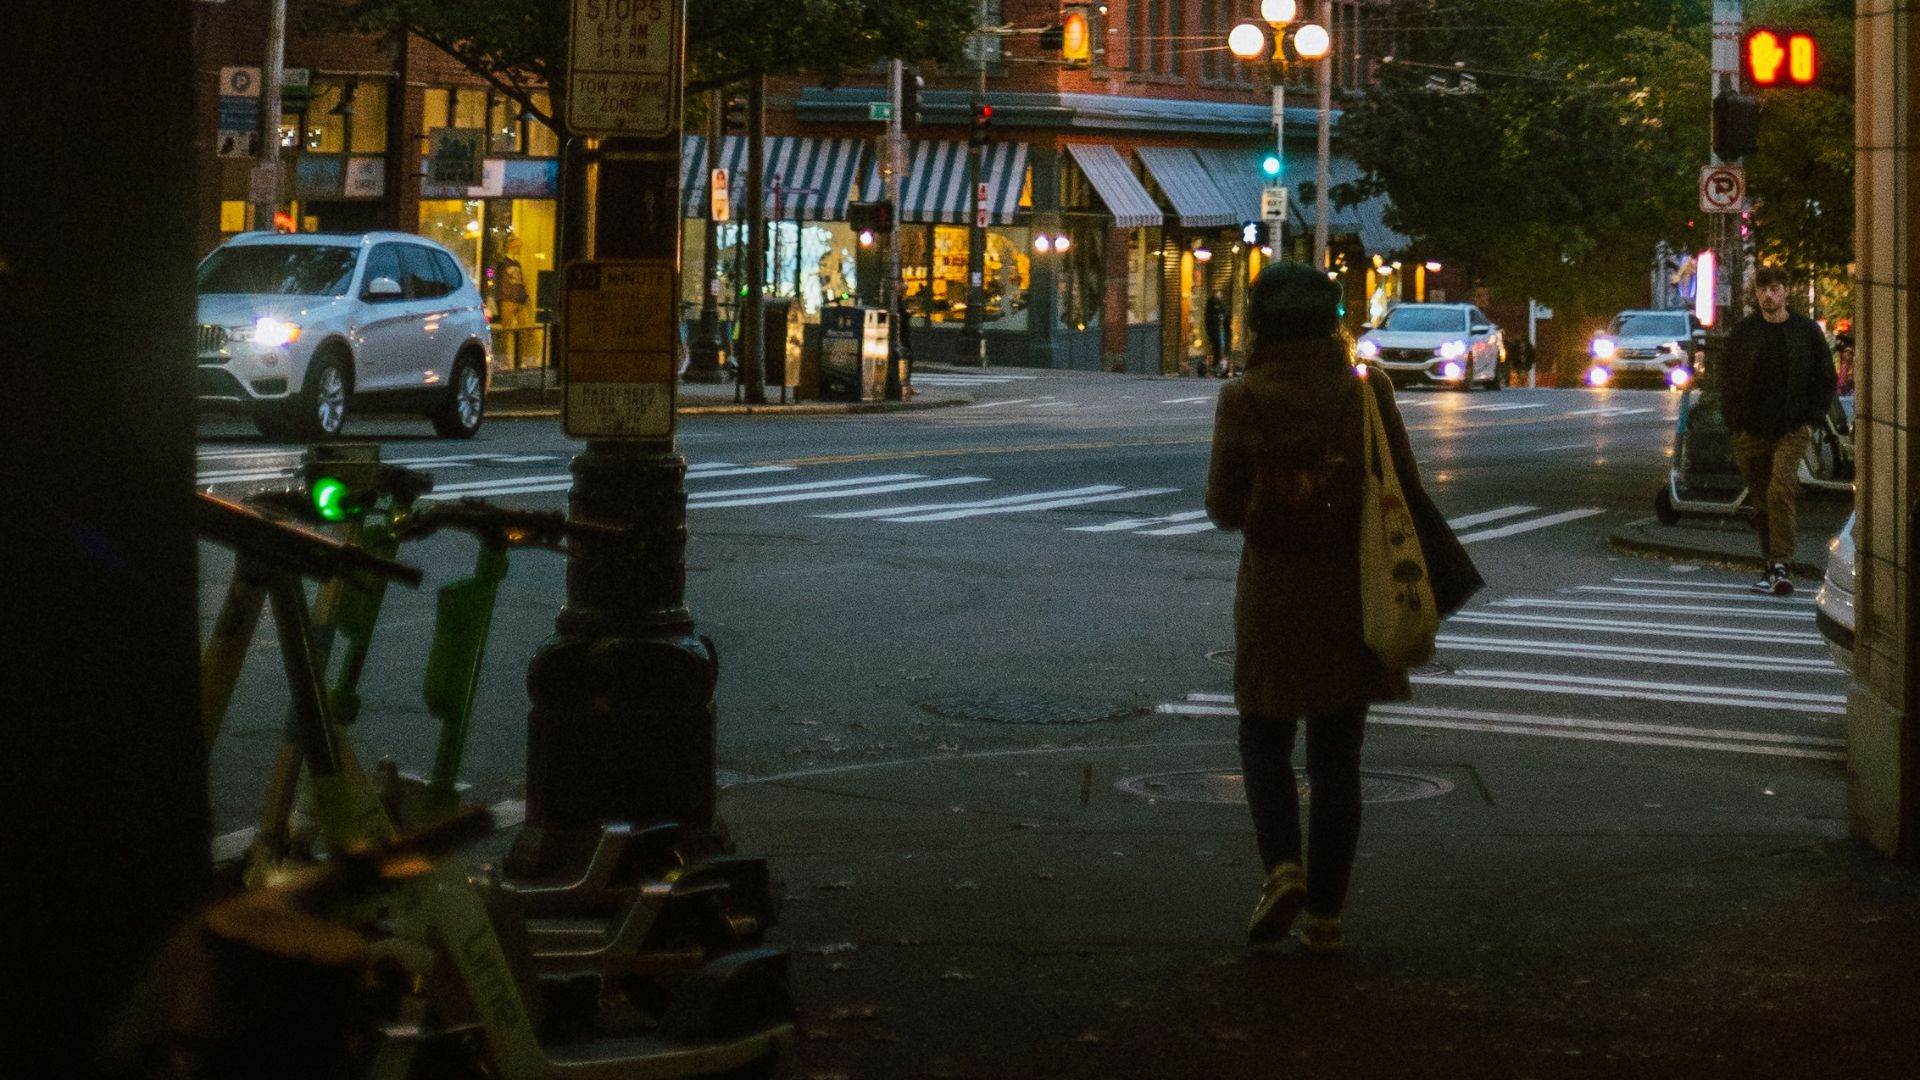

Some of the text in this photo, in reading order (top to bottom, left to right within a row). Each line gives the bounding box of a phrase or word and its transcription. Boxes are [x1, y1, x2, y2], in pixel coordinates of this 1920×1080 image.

[587, 0, 661, 21] STOPS
[630, 23, 649, 40] AM
[628, 43, 647, 60] PM
[1790, 36, 1813, 82] 8
[579, 79, 664, 95] TOW-AWAY
[600, 96, 638, 112] ZONE
[607, 271, 666, 287] MINUTE
